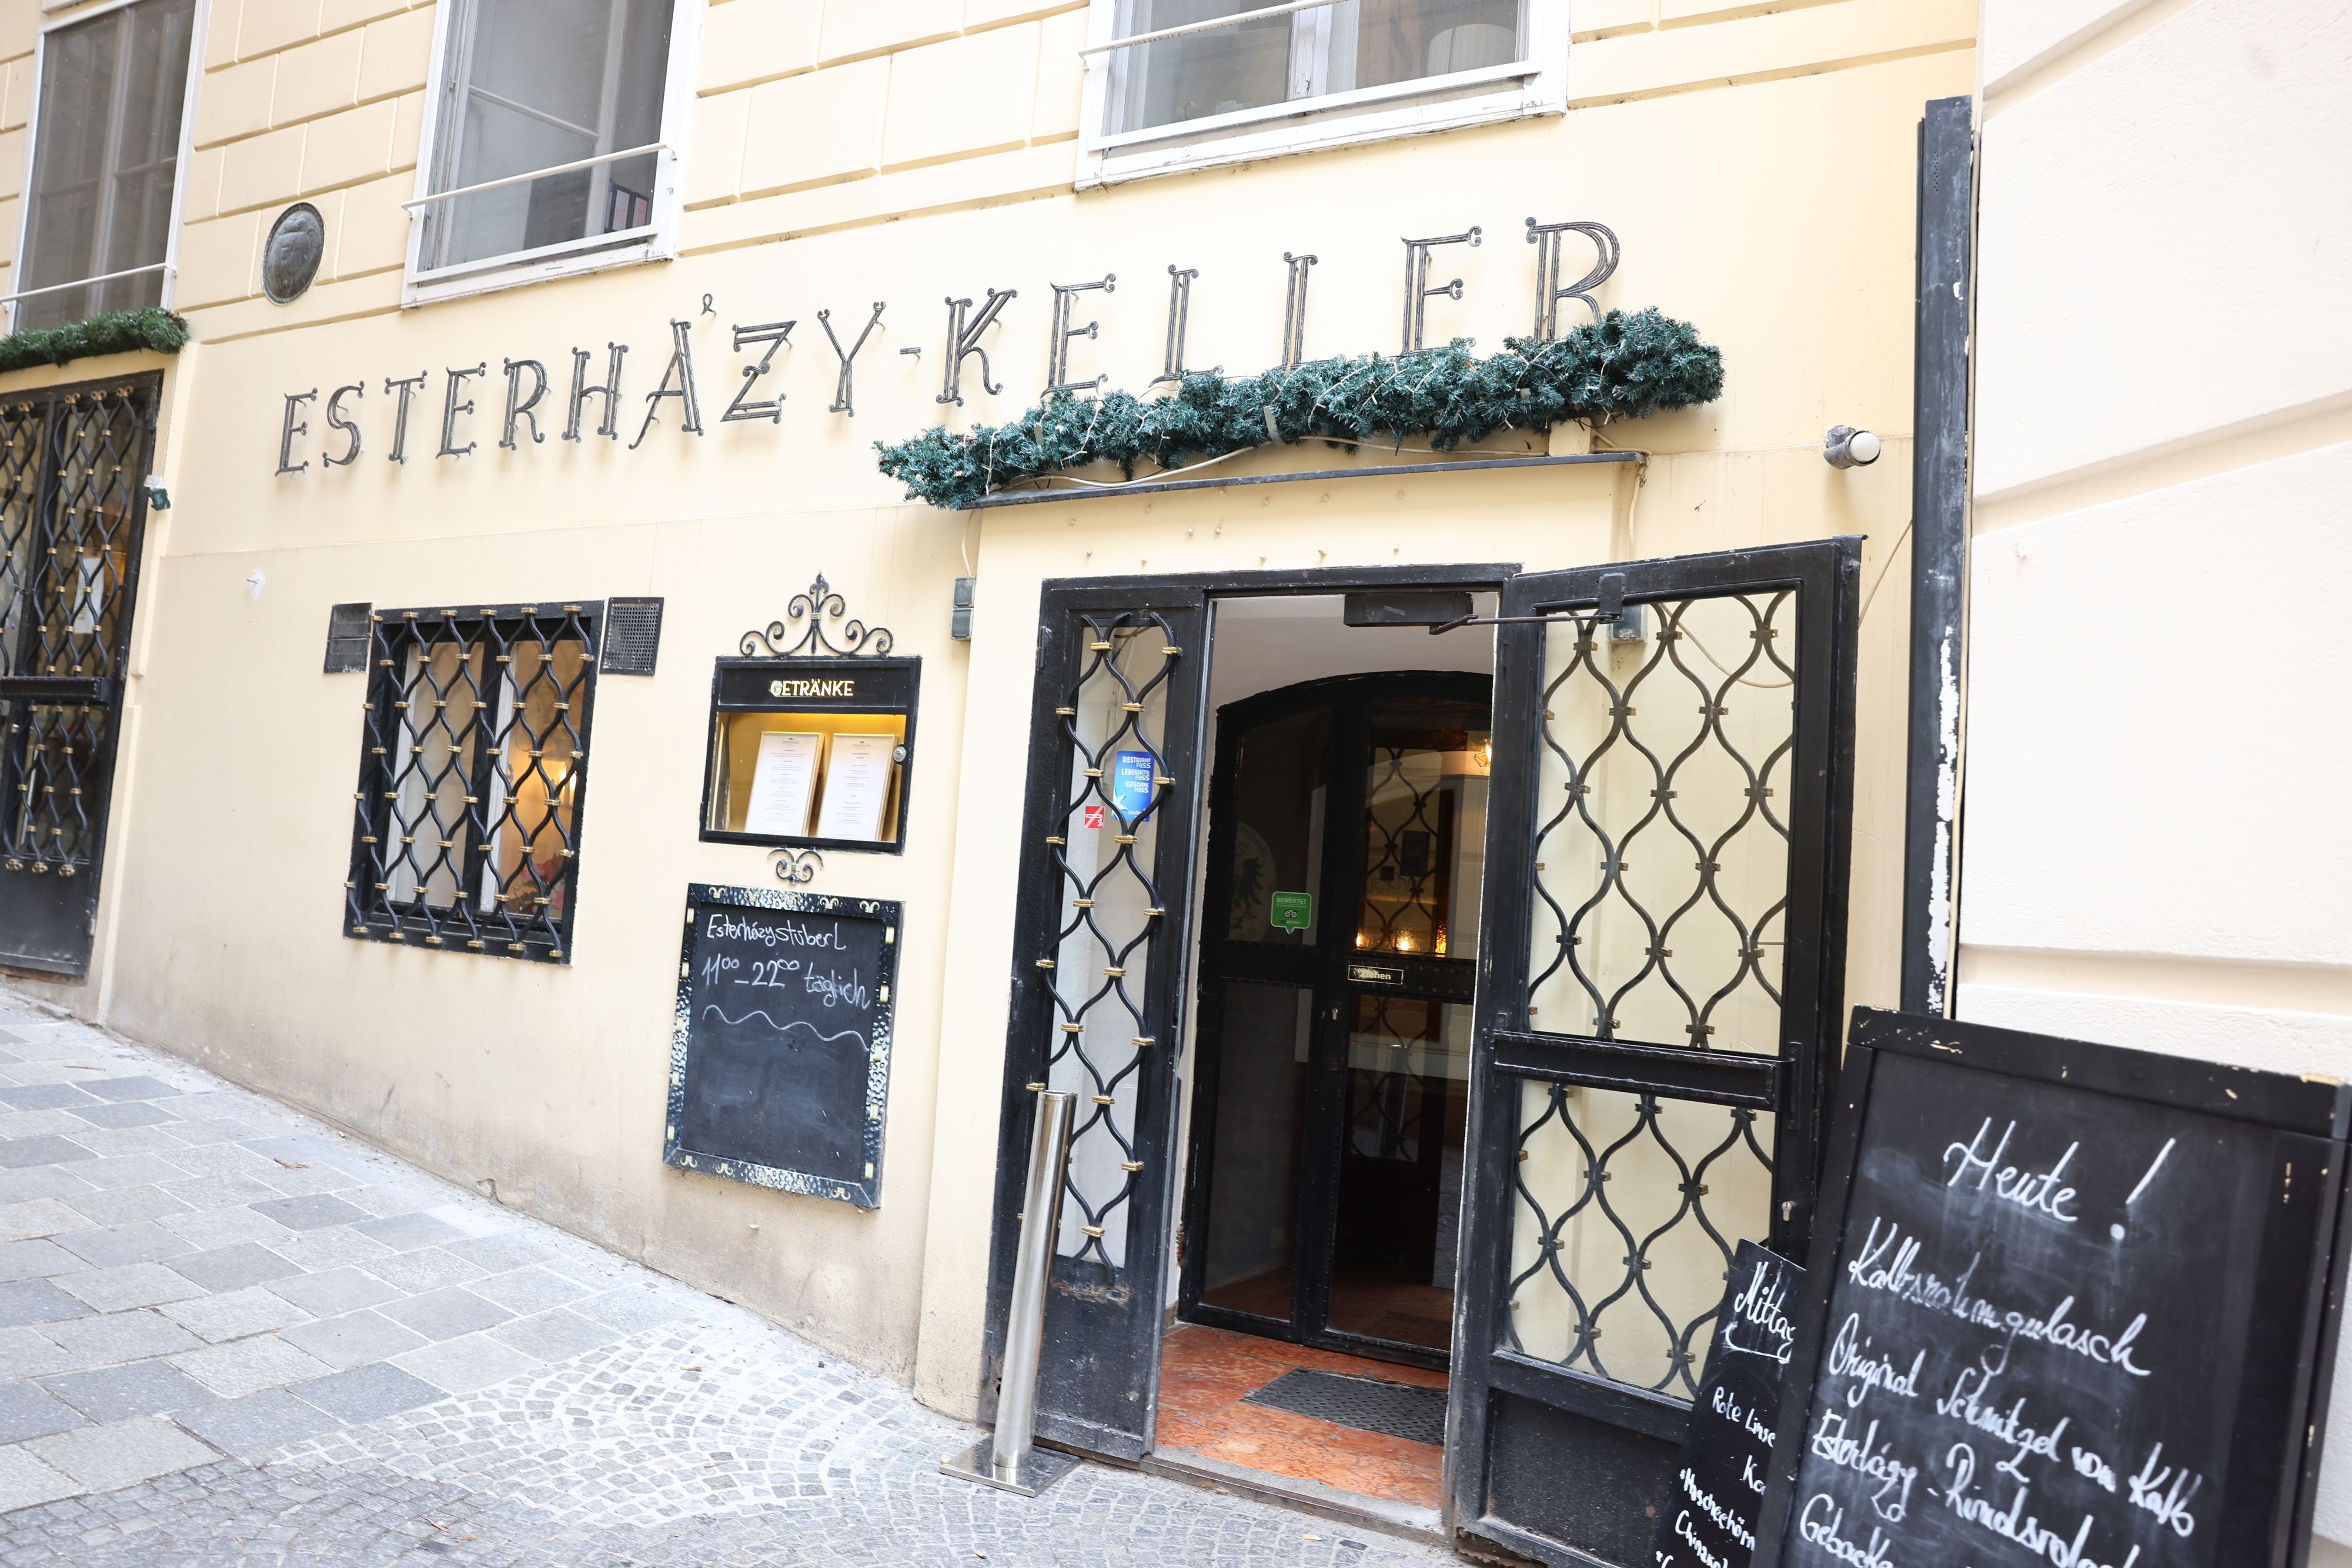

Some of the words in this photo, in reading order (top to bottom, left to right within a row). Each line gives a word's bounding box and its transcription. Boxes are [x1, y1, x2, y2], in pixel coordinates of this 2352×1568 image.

[770, 678, 855, 697] GETRÄNKE
[803, 962, 870, 1011] täglich
[1943, 1117, 2079, 1222] Heute
[1712, 1386, 1742, 1423] Rote
